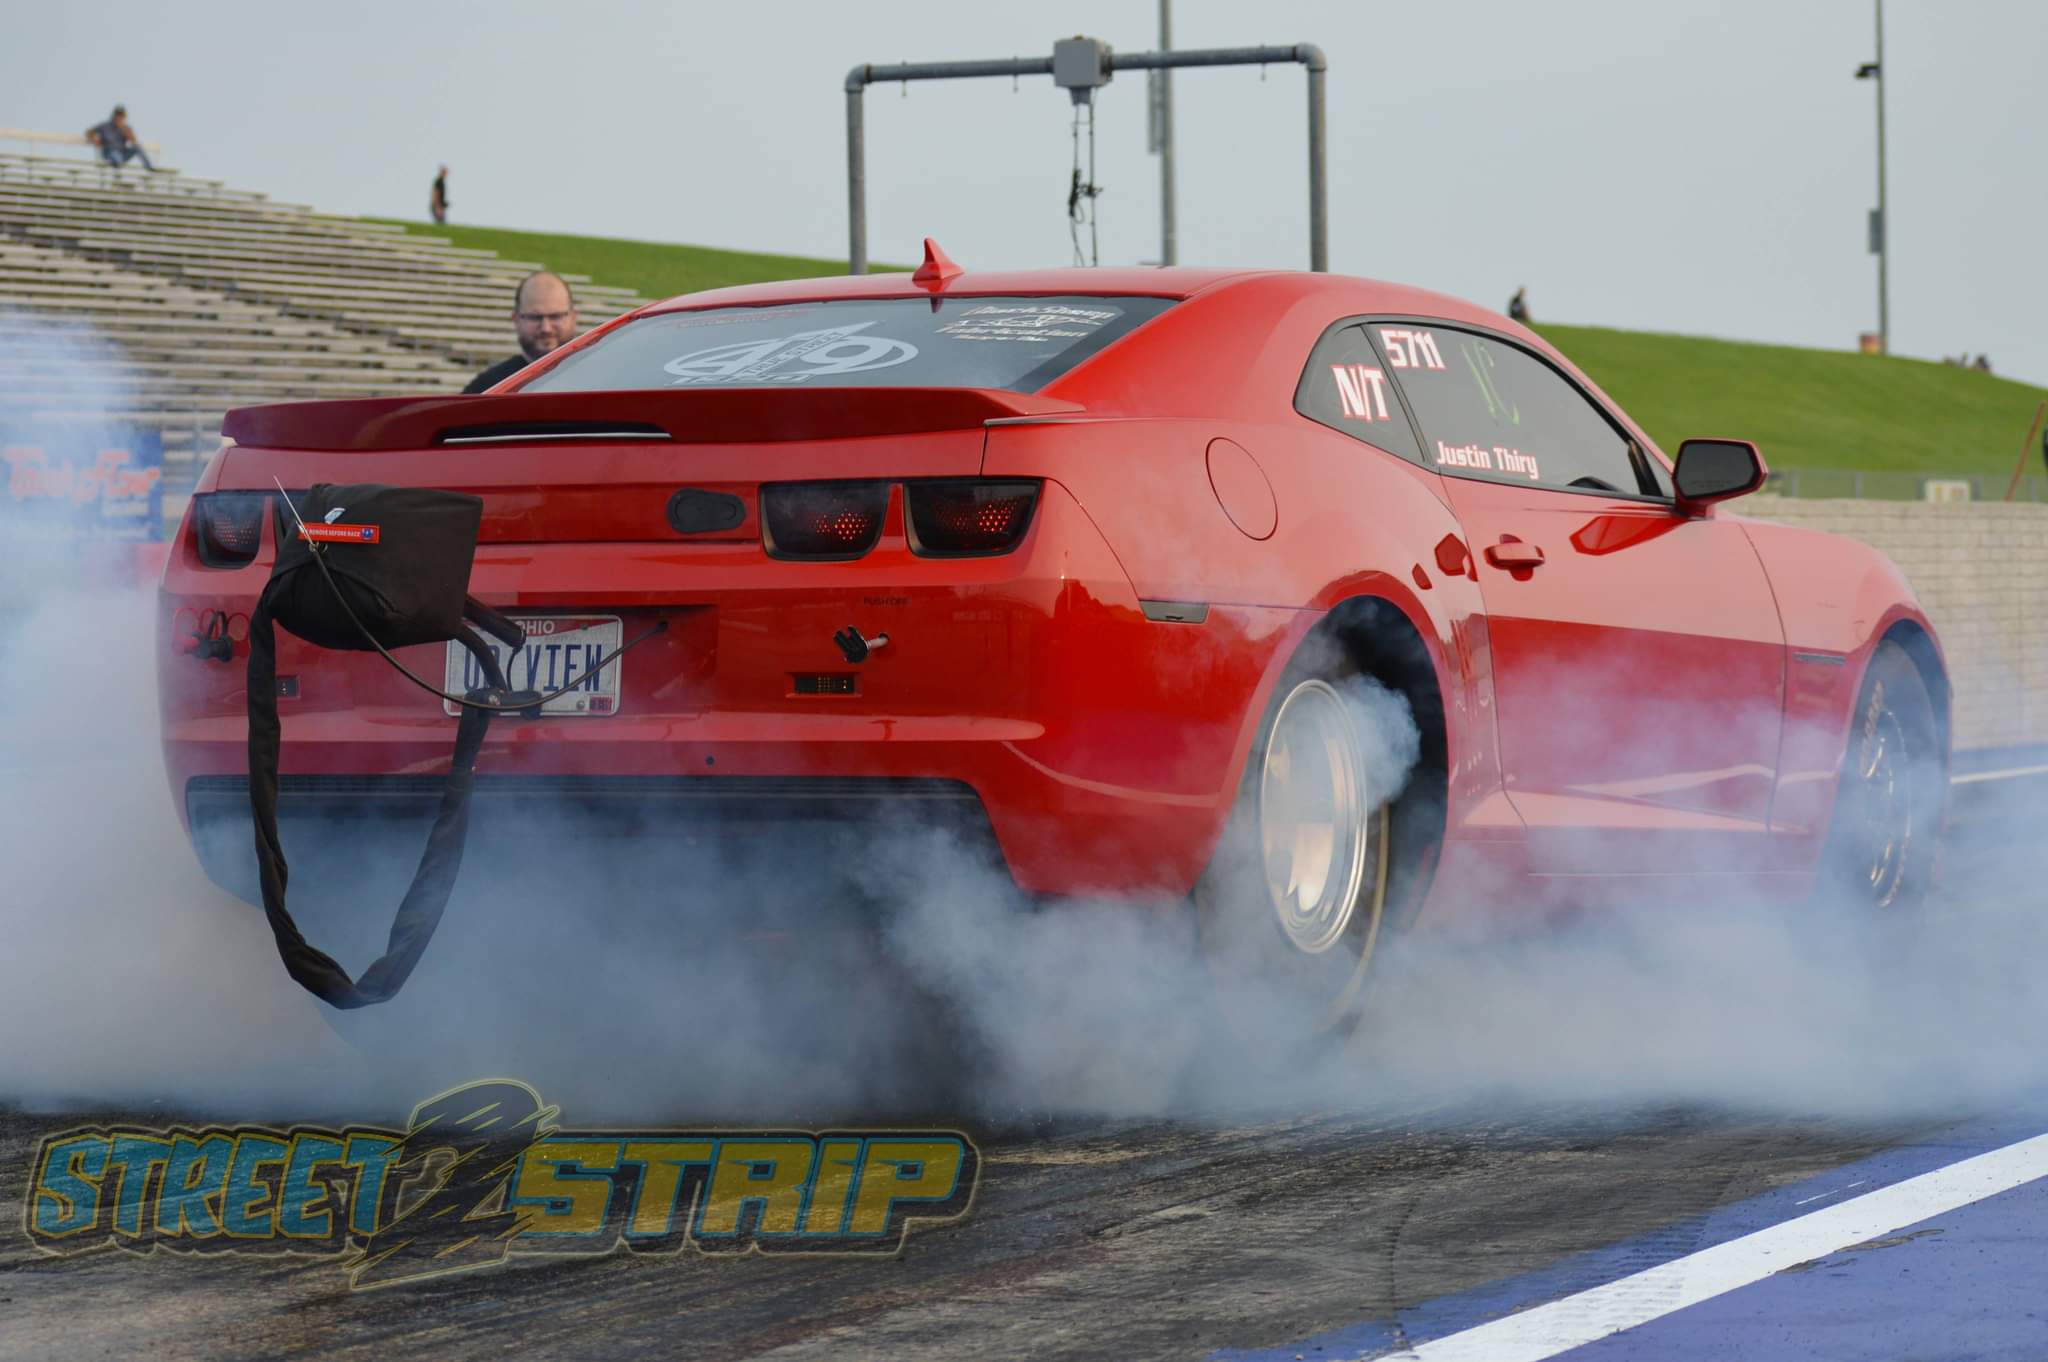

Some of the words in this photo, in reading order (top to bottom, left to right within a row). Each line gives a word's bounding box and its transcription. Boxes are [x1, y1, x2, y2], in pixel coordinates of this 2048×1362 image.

[1380, 329, 1446, 369] 5711
[1331, 364, 1391, 422] N/T
[1436, 441, 1492, 468] Justin
[1493, 447, 1539, 480] Thiry
[526, 644, 602, 692] VIEW
